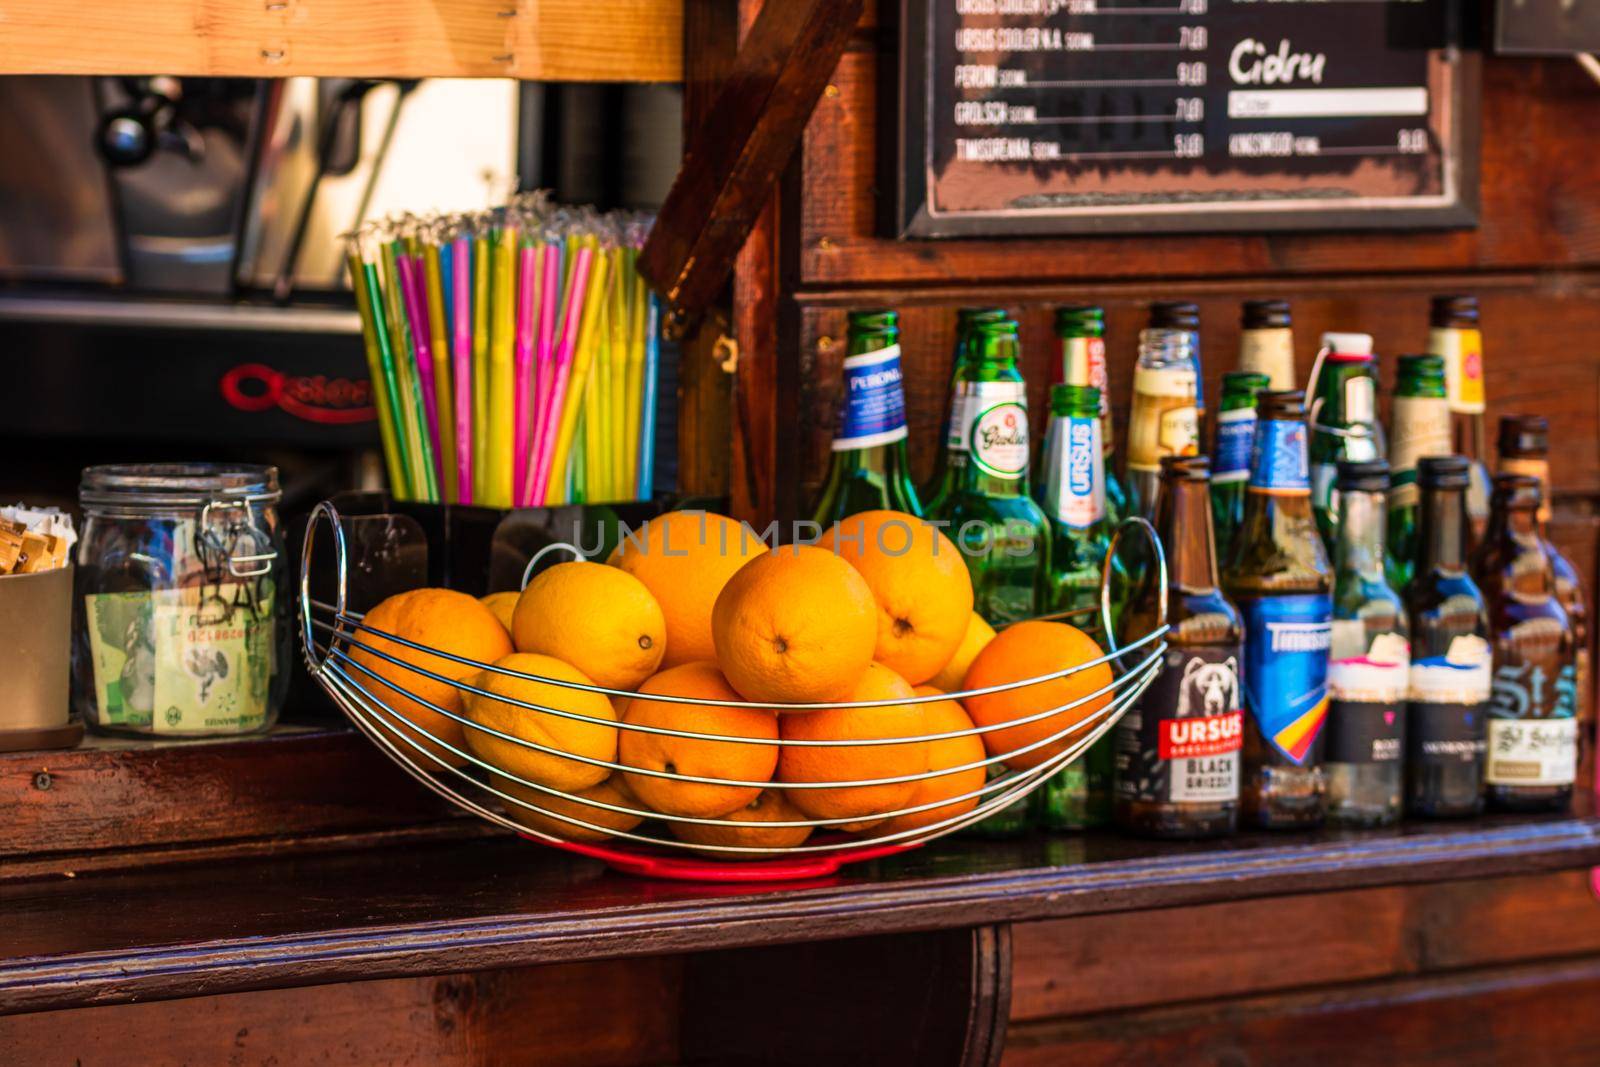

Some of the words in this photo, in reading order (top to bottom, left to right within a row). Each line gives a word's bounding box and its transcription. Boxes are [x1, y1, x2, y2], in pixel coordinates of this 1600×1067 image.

[956, 28, 995, 51] URSUS
[997, 28, 1040, 51] COOLER
[1229, 38, 1326, 84] Cidru
[954, 101, 1008, 125] GROLSCH
[1072, 424, 1091, 491] URSUS
[1170, 715, 1241, 744] URSUS
[1186, 758, 1233, 775] BLACK
